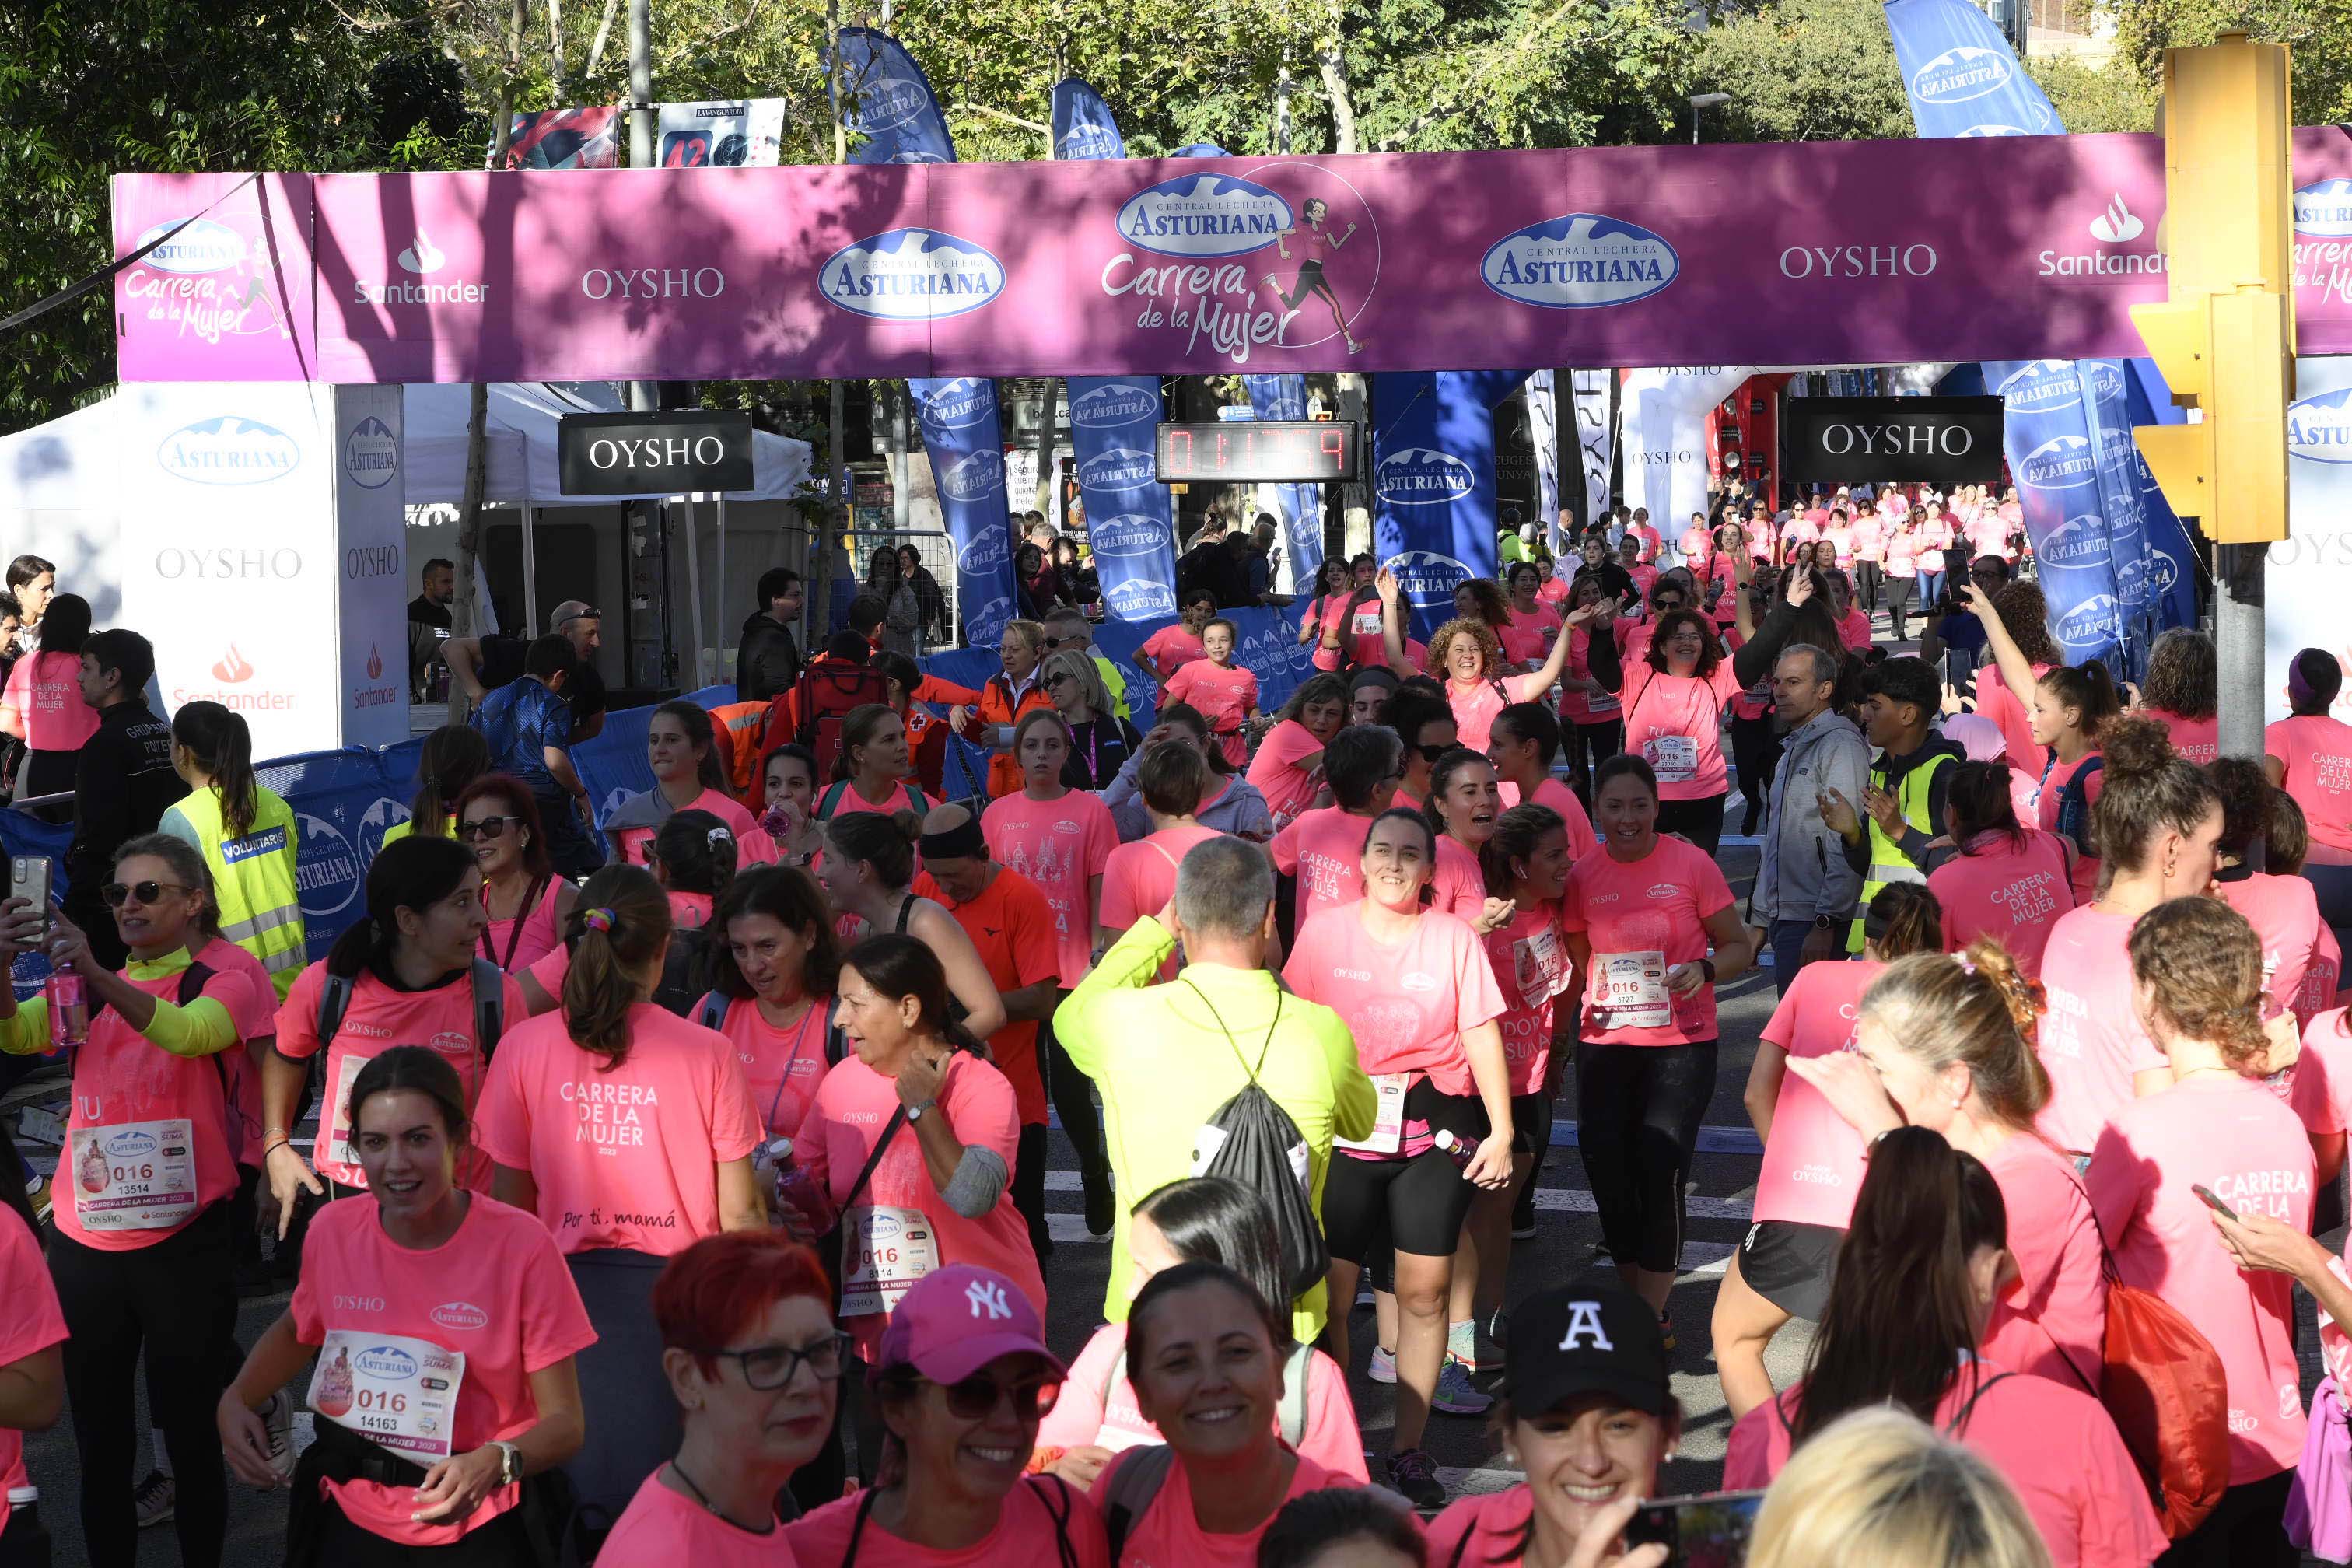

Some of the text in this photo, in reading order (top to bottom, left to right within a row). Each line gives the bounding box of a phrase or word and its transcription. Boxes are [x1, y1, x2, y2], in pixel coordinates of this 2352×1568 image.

[708, 108, 744, 117] VANGUARDIA
[1157, 201, 1274, 211] CENTRAL LECHERA
[1129, 206, 1279, 236] ASTURIANA
[1527, 245, 1657, 257] CENTRAL LECHERA
[861, 258, 985, 269] CENTRAL LECHERA
[1496, 250, 1664, 285] ASTURIANA
[1780, 244, 1937, 279] OYSHO
[2039, 250, 2168, 276] Santand
[125, 270, 215, 299] Carrera
[582, 268, 725, 299] OYSHO
[832, 264, 992, 297] ASTURIANA
[1101, 253, 1247, 296] Carrera
[355, 280, 489, 304] Santander
[148, 299, 251, 345] de la Mujer
[1137, 292, 1301, 363] de la Mujer
[1822, 424, 1972, 456] OYSHO
[2288, 418, 2352, 445] ASTU
[170, 443, 290, 468] ASTURIANA
[349, 443, 394, 471] ASTURIANA
[590, 436, 724, 470] OYSHO
[1495, 456, 1532, 465] EUGES
[1633, 450, 1691, 464] OYSHO
[1379, 471, 1467, 492] ASTURIANA
[1496, 471, 1531, 480] UNYA
[156, 548, 303, 579] OYSHO
[348, 544, 399, 579] OYSHO
[31, 683, 70, 691] CARRERA
[38, 691, 62, 700] DE LA
[355, 684, 397, 709] Santander
[37, 701, 64, 709] MUJER
[126, 723, 152, 738] GRUP
[1649, 726, 1664, 737] TU
[2180, 744, 2218, 757] ARRER
[2321, 765, 2350, 778] DE LA
[2316, 776, 2351, 791] MUJER
[223, 832, 285, 859] VOLUNTARIS
[1300, 849, 1351, 877] CARRERA
[296, 856, 356, 892] STURIANA
[1307, 865, 1337, 886] DE LA
[1302, 877, 1339, 899] MUJER
[1990, 870, 2055, 904] CARRERA
[1048, 898, 1071, 912] SAL
[1590, 893, 1619, 905] OYSHO
[2008, 888, 2049, 913] DE LA
[2012, 898, 2056, 926] MUJER
[1333, 968, 1371, 982] OYSHO
[1612, 982, 1639, 993] 016
[2308, 980, 2322, 994] LA
[345, 1020, 393, 1039] OYSHO
[1504, 1015, 1540, 1036] DOR
[560, 1081, 659, 1107] CARRERA
[579, 1104, 639, 1125] DE LA
[843, 1111, 878, 1124] OYSHO
[576, 1126, 644, 1146] MUJER
[109, 1141, 153, 1153] ASTURIANA
[598, 1146, 617, 1157] 2023
[114, 1164, 153, 1181] 016
[118, 1184, 150, 1195] 13514
[2214, 1170, 2309, 1199] CARRERA
[89, 1214, 122, 1224] OYSHO
[151, 1210, 188, 1220] Santander
[563, 1212, 583, 1229] Por
[614, 1209, 676, 1229] mamá
[862, 1248, 898, 1264] 016
[869, 1269, 892, 1278] 8114
[965, 1279, 1012, 1321] NY
[1559, 1300, 1614, 1352] A
[361, 1358, 413, 1374] ASTURIANA
[422, 1359, 452, 1371] SUMA
[358, 1389, 407, 1412] 016
[360, 1416, 397, 1431] 14163
[376, 1435, 387, 1444] LA
[389, 1437, 415, 1448] MUJER
